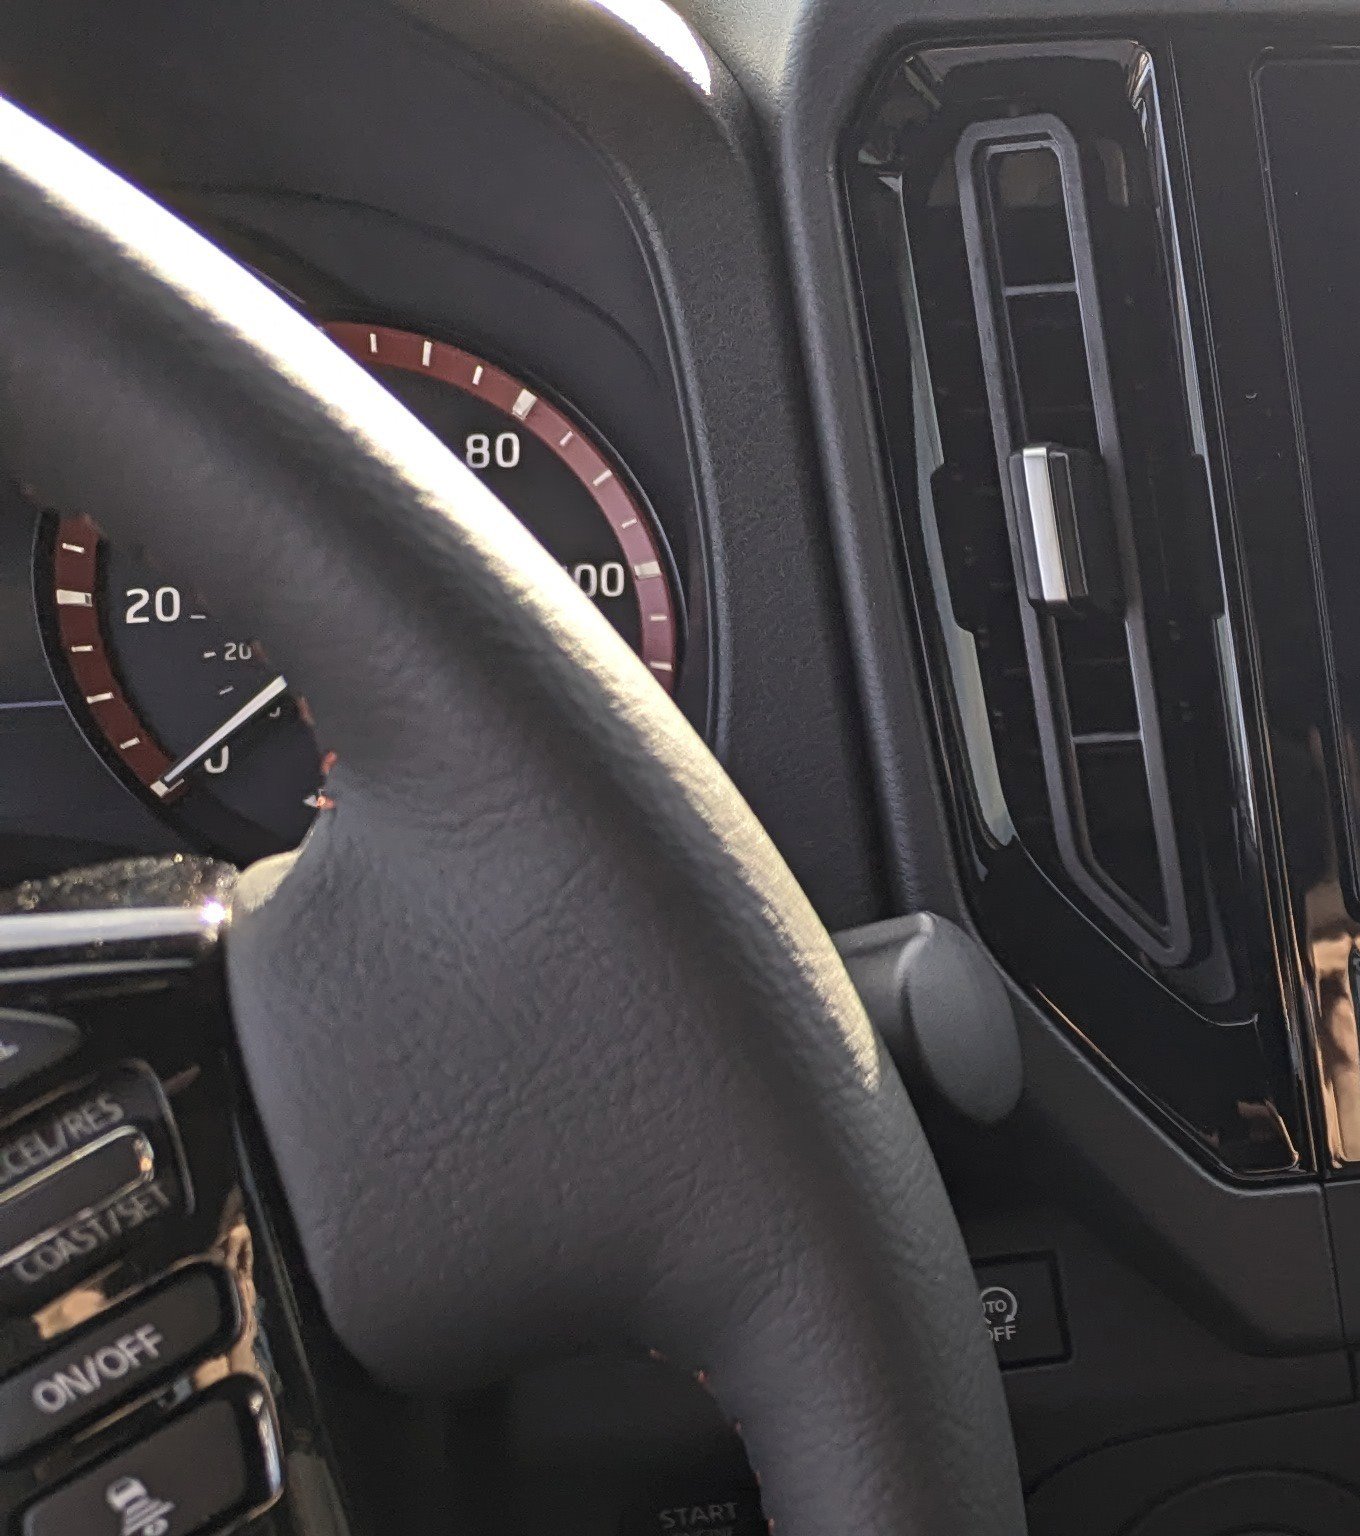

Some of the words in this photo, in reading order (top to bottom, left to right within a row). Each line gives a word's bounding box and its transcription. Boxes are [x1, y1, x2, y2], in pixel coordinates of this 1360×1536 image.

[465, 432, 521, 469] 80
[564, 562, 625, 597] 00
[125, 586, 181, 624] 20
[982, 1300, 1007, 1313] TO
[31, 1325, 162, 1413] ON/OFF
[658, 1502, 738, 1529] START
